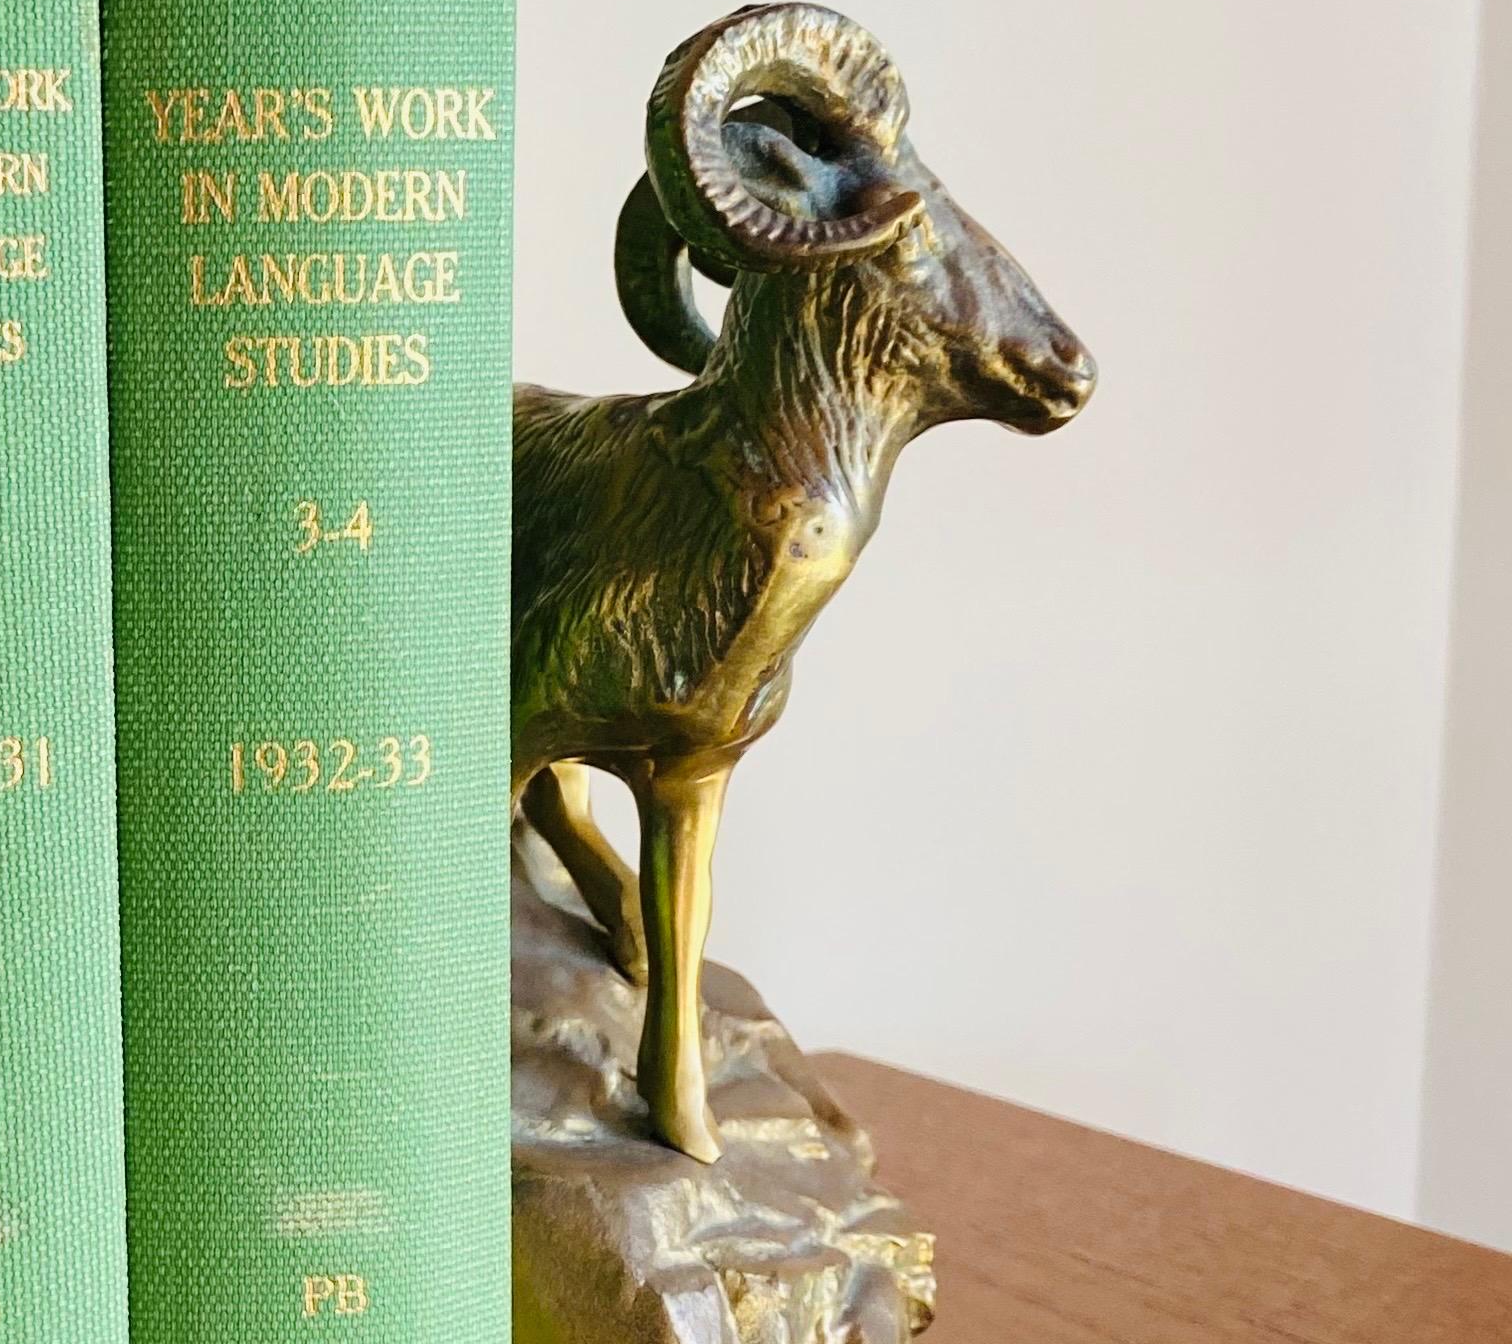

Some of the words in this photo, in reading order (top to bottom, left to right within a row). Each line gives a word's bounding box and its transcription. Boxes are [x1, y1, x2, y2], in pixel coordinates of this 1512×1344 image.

[145, 88, 333, 143] YEAR'S
[352, 87, 496, 142] WORK
[180, 172, 234, 224] IN
[258, 170, 467, 222] MODERN
[189, 251, 460, 306] LANGUAGE
[224, 333, 430, 390] STUDIES
[294, 501, 373, 554] 3-4
[230, 735, 431, 795] 1932-33
[302, 1274, 368, 1319] PB
